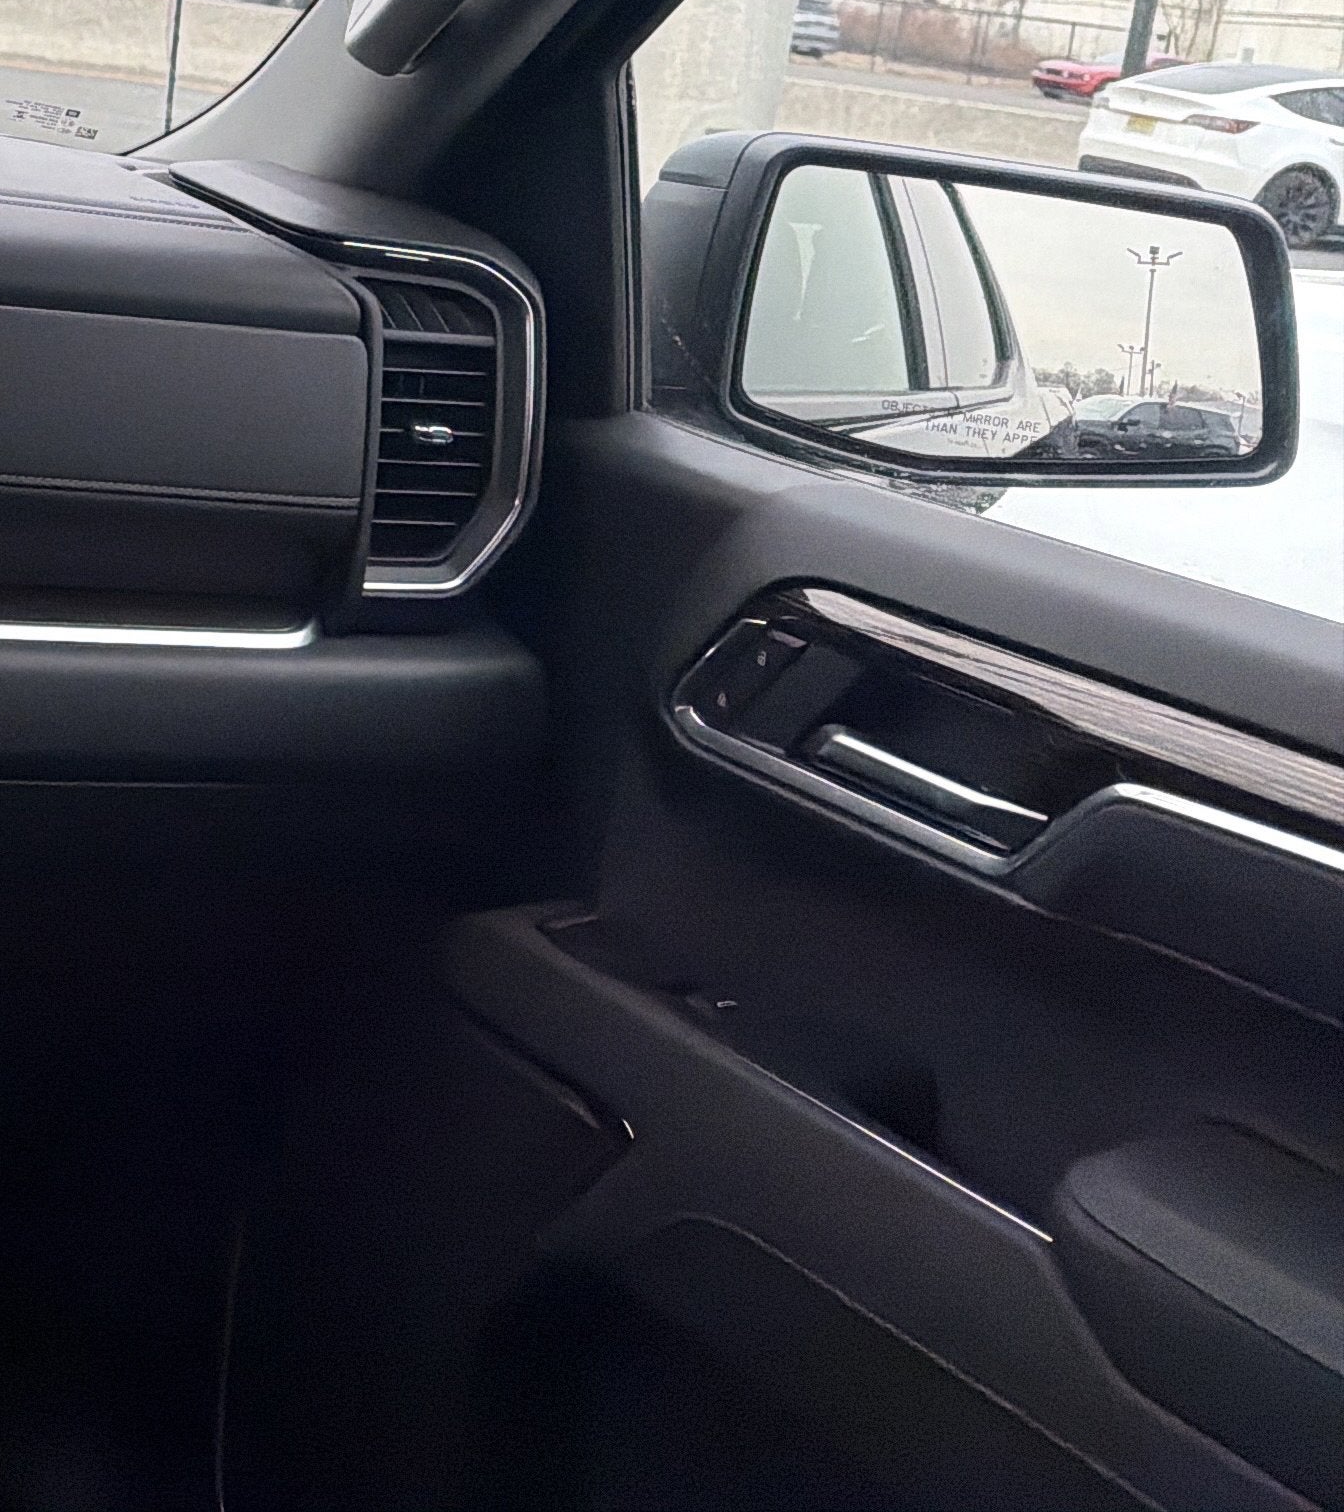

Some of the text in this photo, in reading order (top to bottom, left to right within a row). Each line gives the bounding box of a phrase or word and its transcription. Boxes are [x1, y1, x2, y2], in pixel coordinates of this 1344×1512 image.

[924, 418, 958, 435] THAN
[966, 426, 997, 441] THEY
[963, 412, 1009, 428] MIRROR
[1016, 421, 1041, 433] ARE
